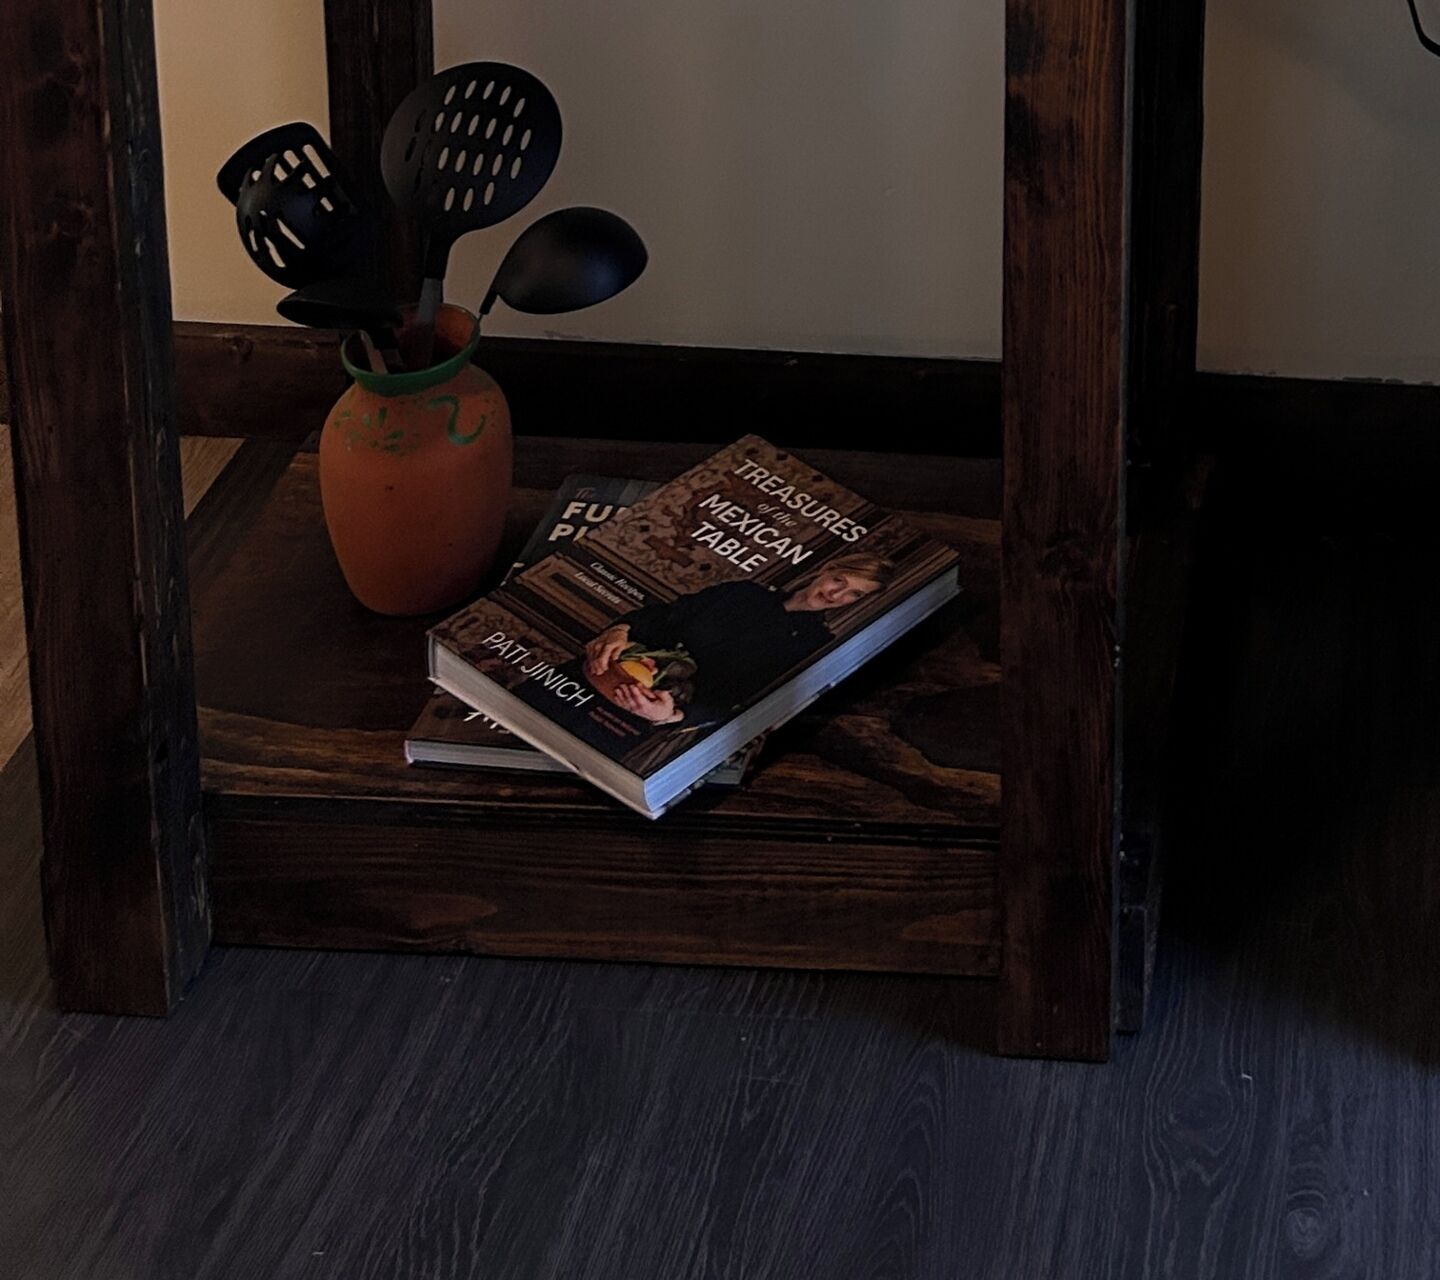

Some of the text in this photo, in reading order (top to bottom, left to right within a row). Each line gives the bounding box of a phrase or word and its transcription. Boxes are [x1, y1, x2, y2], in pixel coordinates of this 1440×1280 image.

[561, 501, 629, 523] FU
[698, 493, 814, 566] MEXICAN
[733, 458, 868, 543] TREASURES
[756, 502, 799, 528] of the
[690, 520, 768, 573] TABLE
[481, 631, 596, 708] PATI JINICH
